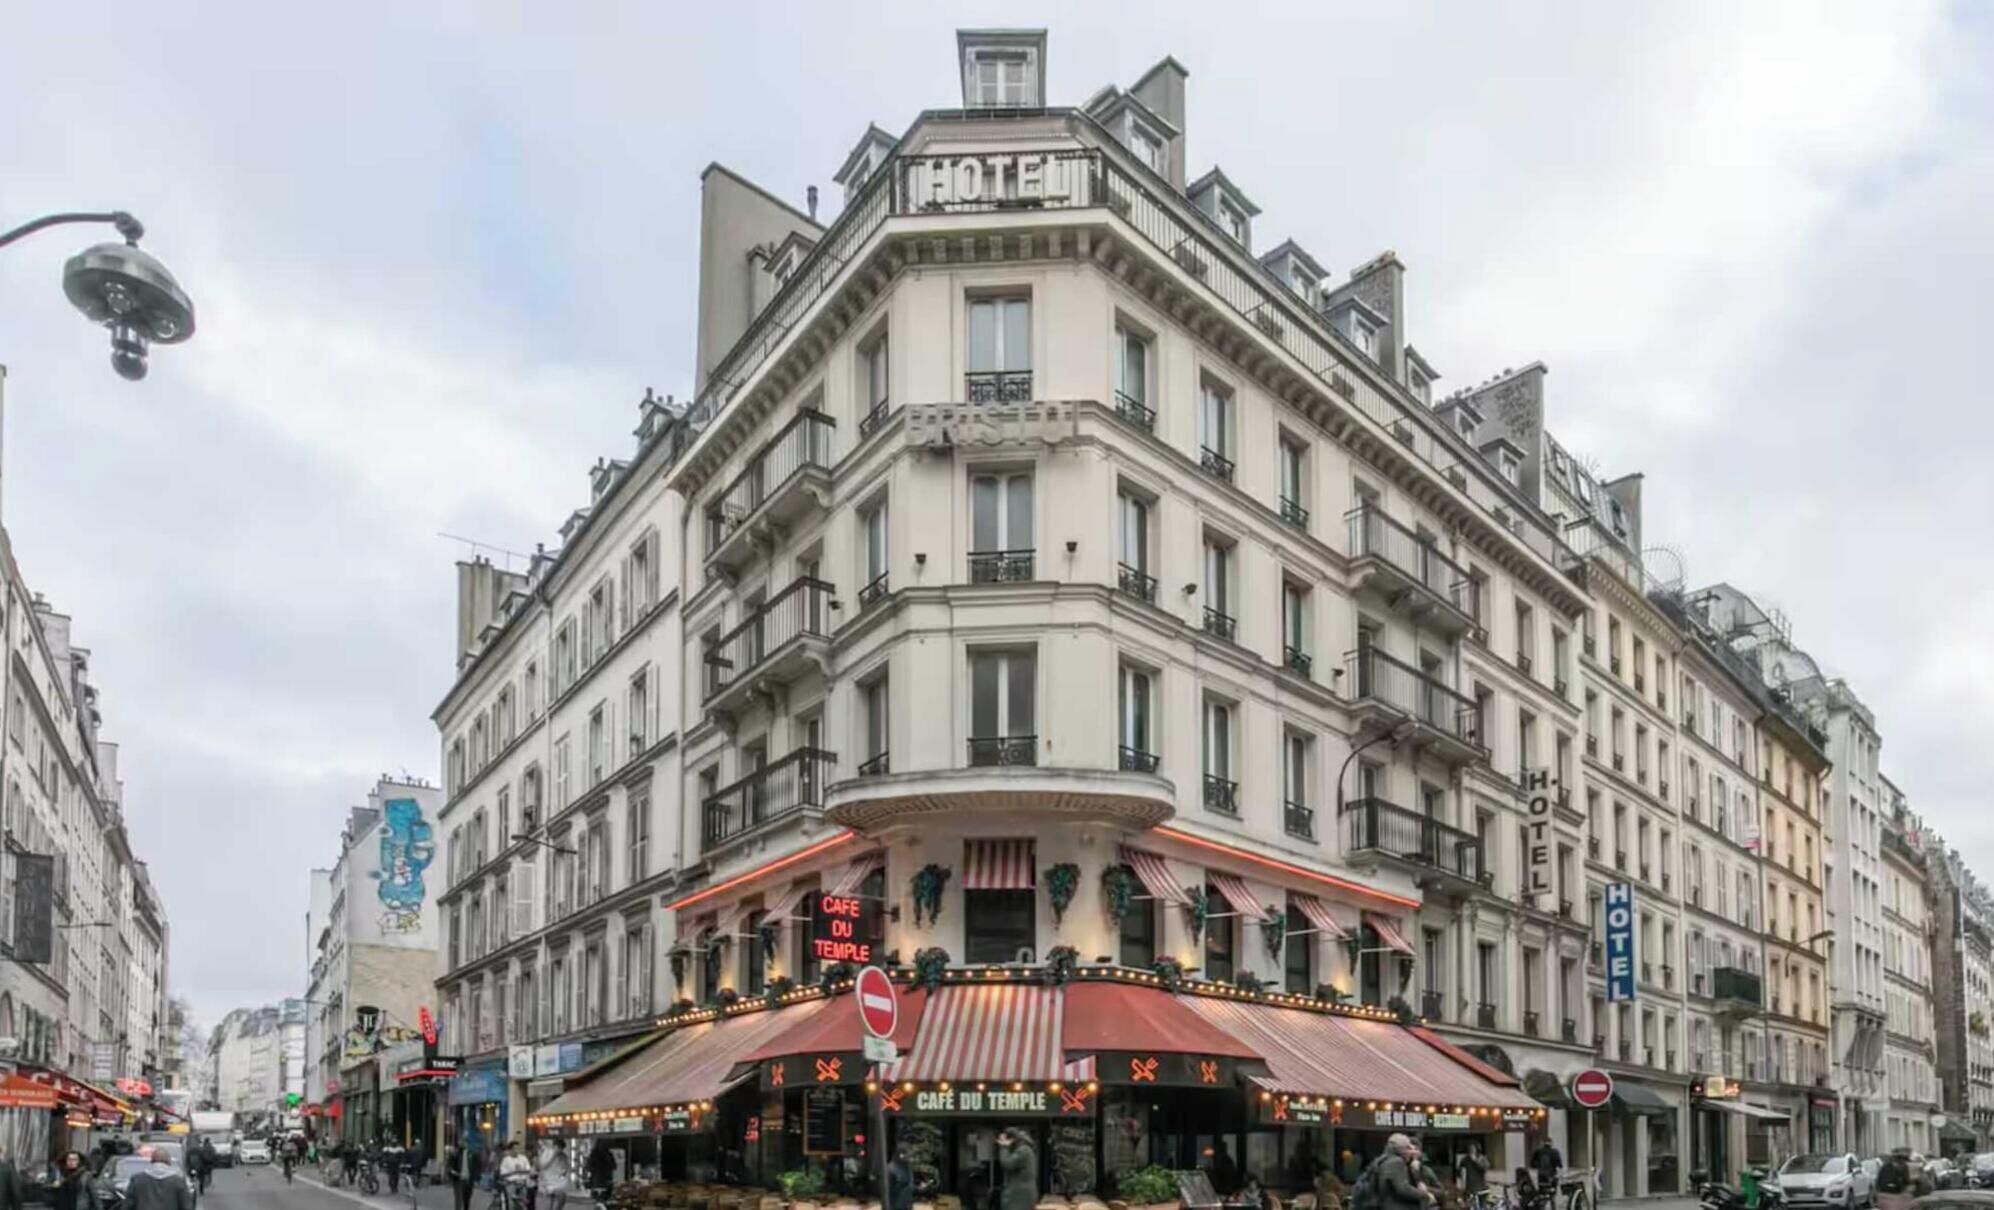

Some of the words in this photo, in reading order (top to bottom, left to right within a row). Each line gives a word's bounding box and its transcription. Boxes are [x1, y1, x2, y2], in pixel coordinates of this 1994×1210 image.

[1529, 769, 1548, 891] HOTEL
[823, 895, 860, 917] CAFE
[832, 919, 853, 938] DU
[815, 939, 869, 962] TEMPLE
[1608, 883, 1630, 1001] HOTEL
[917, 1088, 955, 1110] CAFÉ
[960, 1091, 983, 1110] DU
[988, 1091, 1047, 1110] TEMPLE
